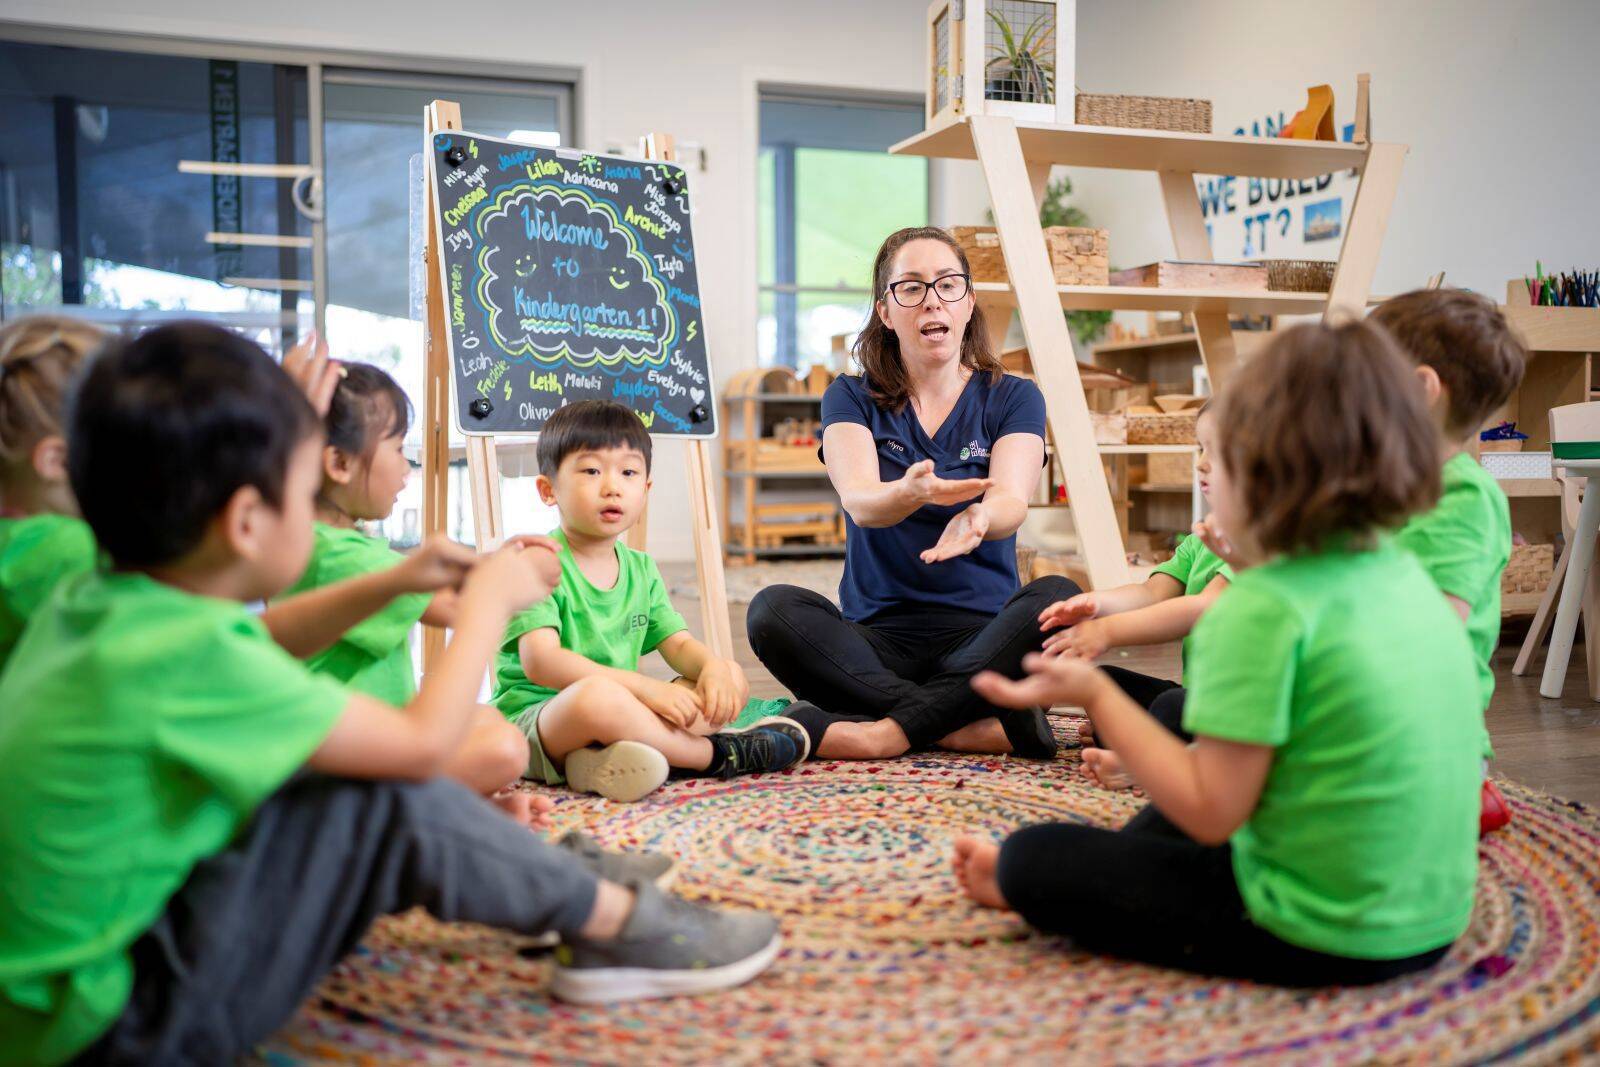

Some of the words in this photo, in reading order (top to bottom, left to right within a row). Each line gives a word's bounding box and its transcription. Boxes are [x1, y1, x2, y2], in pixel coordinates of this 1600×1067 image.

[444, 168, 467, 187] Miss
[464, 164, 489, 188] Myra
[444, 187, 488, 227] Chelsea
[644, 183, 666, 206] Miss
[520, 204, 610, 250] Welcome
[445, 228, 473, 252] Ivy
[513, 285, 633, 337] Kindergarten
[636, 307, 658, 330] 1!
[460, 351, 493, 377] Leah
[612, 378, 660, 403] Jayden
[647, 369, 686, 397] Evelyn
[887, 440, 904, 452] Myra
